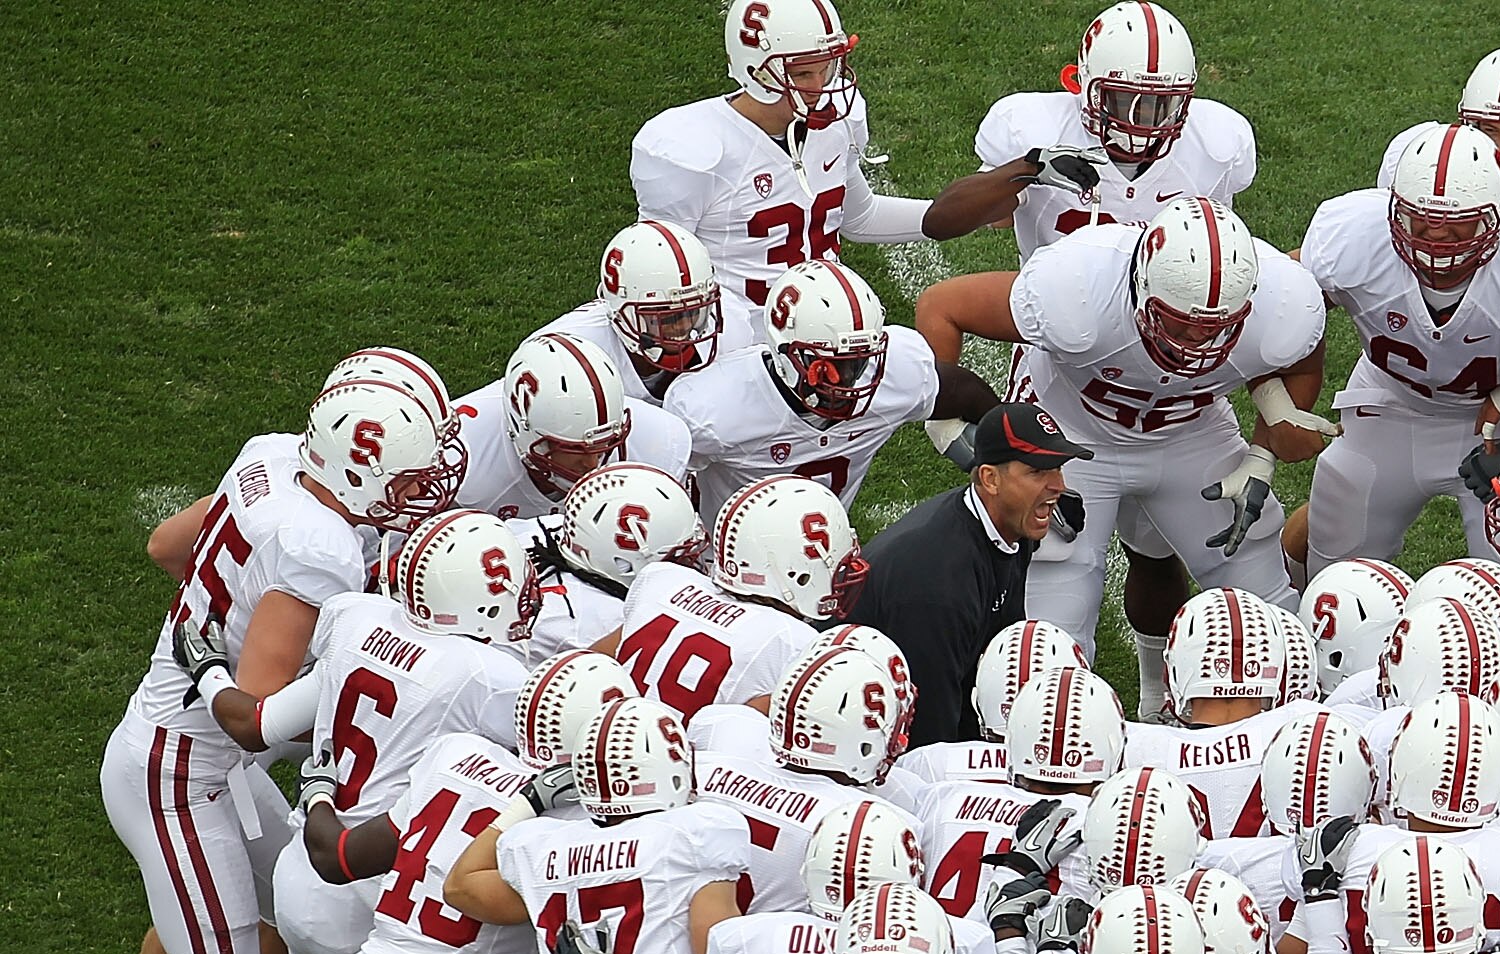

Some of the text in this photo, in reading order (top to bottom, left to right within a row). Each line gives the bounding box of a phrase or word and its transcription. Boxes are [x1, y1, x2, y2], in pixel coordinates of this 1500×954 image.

[740, 2, 769, 48] S
[1428, 198, 1450, 207] CARDINAL
[604, 247, 624, 295] S
[771, 285, 801, 330] S
[1370, 335, 1497, 400] 64
[350, 419, 385, 466] S
[614, 504, 650, 552] S
[801, 511, 831, 560] S
[480, 547, 512, 596] S
[671, 584, 746, 628] GARDNER
[1313, 592, 1340, 640] S
[361, 627, 427, 672] BROWN
[1245, 662, 1260, 676] 94
[863, 682, 886, 730] S
[1212, 686, 1263, 697] Riddell
[334, 666, 398, 813] 6
[538, 747, 552, 760] 43
[1065, 752, 1081, 765] 47
[1180, 733, 1250, 768] KEISER
[449, 753, 530, 797] AMAJOY
[612, 780, 629, 795] 17
[704, 768, 819, 823] CARRINGTON
[1039, 768, 1076, 780] Riddell
[585, 804, 633, 816] Riddell
[1431, 811, 1468, 824] Riddell
[1464, 801, 1478, 813] 56
[375, 788, 501, 947] 43
[546, 840, 639, 880] G. WHALEN
[860, 944, 899, 954] Riddell
[888, 925, 905, 938] 27
